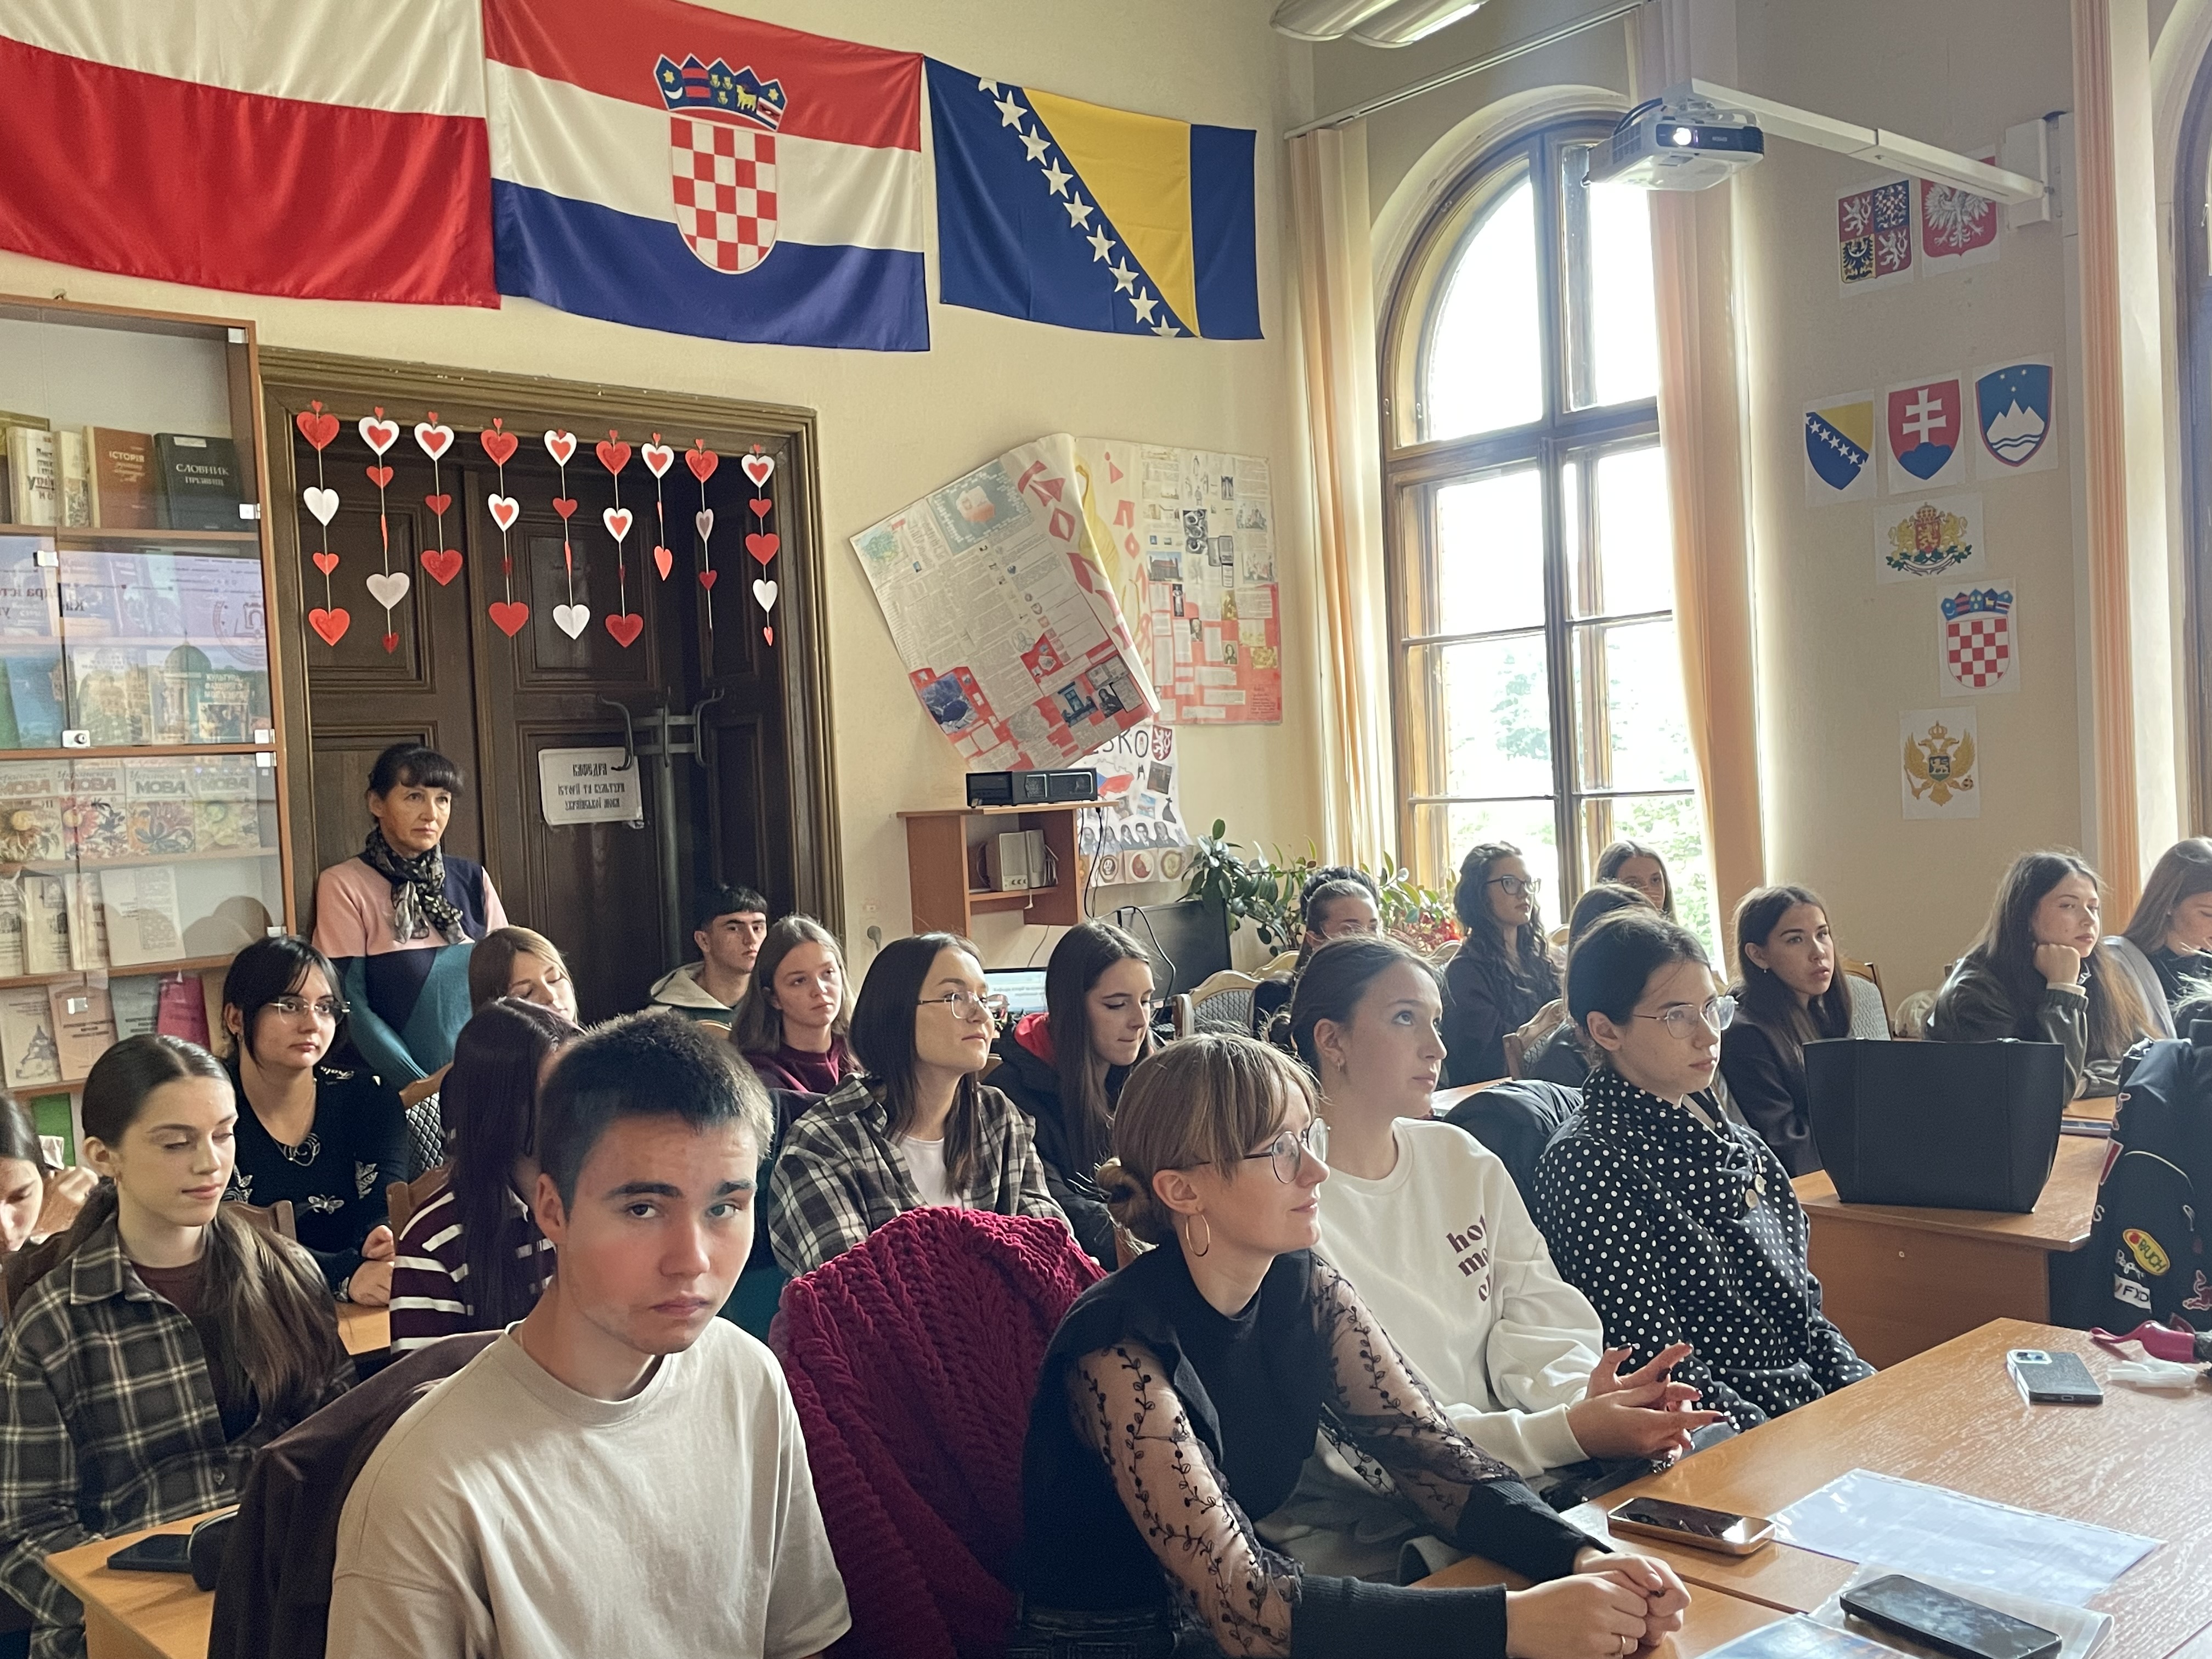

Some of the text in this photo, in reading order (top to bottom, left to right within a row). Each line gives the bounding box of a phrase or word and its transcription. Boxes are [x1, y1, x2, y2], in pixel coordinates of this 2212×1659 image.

[176, 463, 229, 476] СЛОВНИК
[1093, 728, 1149, 758] SKO
[136, 780, 186, 794] МОВА
[583, 783, 592, 794] ТА
[2138, 1238, 2166, 1272] RAUCH
